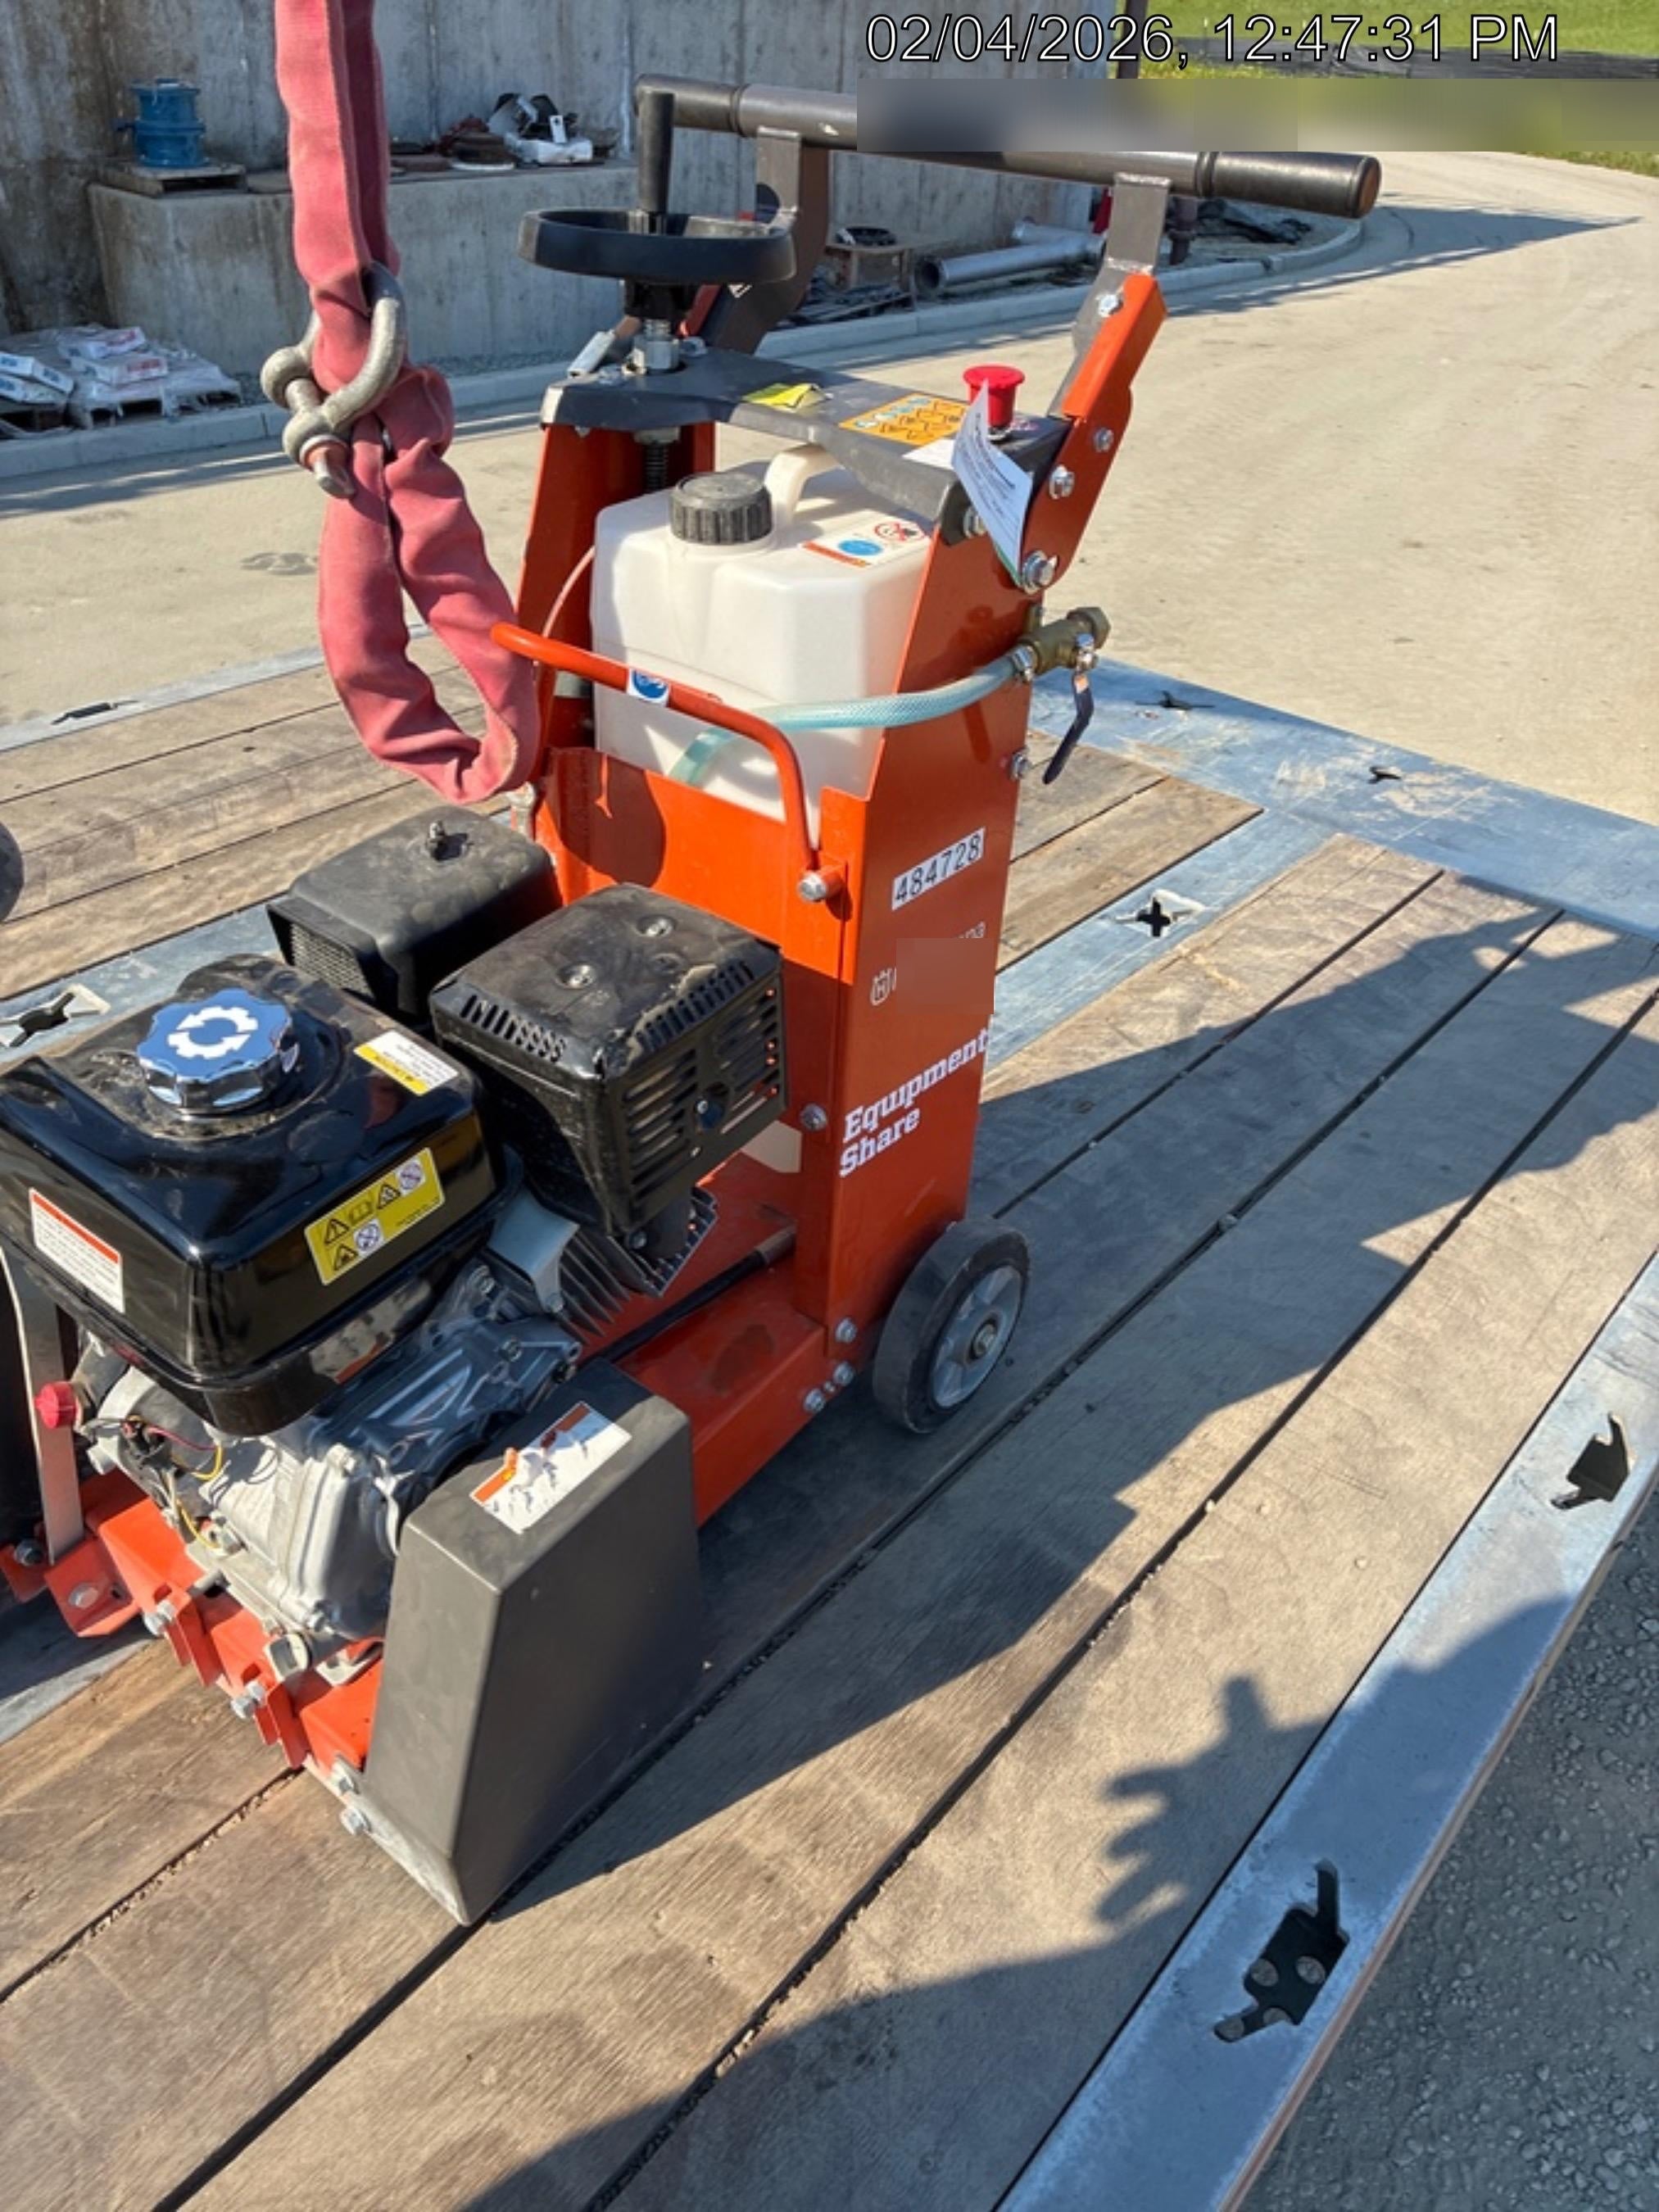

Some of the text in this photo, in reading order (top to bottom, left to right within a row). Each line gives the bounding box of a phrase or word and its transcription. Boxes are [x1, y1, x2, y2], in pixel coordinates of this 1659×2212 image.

[895, 832, 981, 900] 484728
[842, 1027, 990, 1144] Equipment
[840, 1107, 921, 1178] Share
